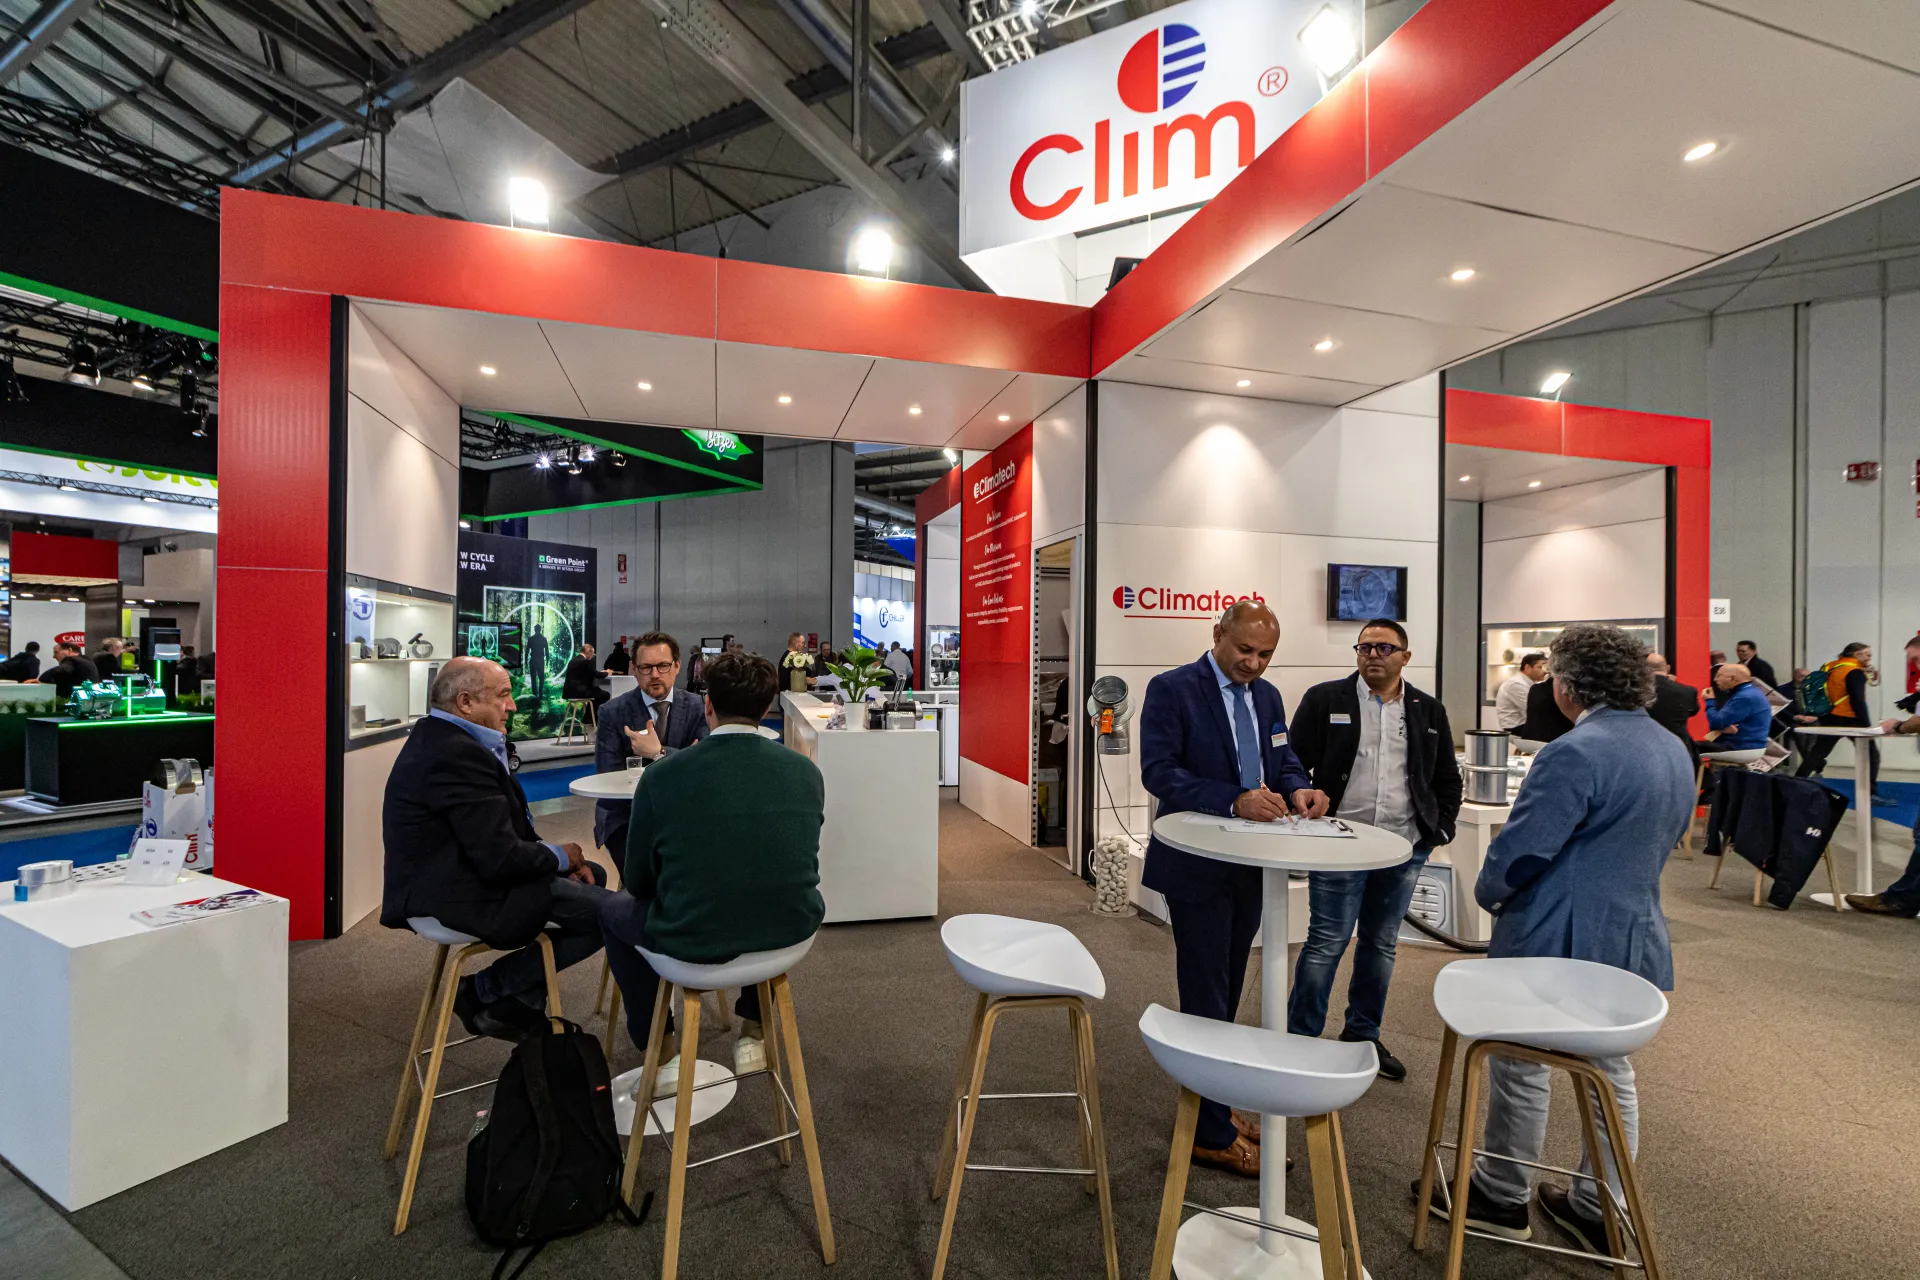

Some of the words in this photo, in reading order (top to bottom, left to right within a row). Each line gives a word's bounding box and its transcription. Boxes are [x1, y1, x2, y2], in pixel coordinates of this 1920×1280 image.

[1010, 101, 1256, 221] Clim
[979, 460, 1015, 495] Climatech
[470, 552, 495, 563] CYCLE
[470, 562, 487, 571] ERA
[546, 555, 567, 565] Green
[1138, 587, 1265, 612] Climate
